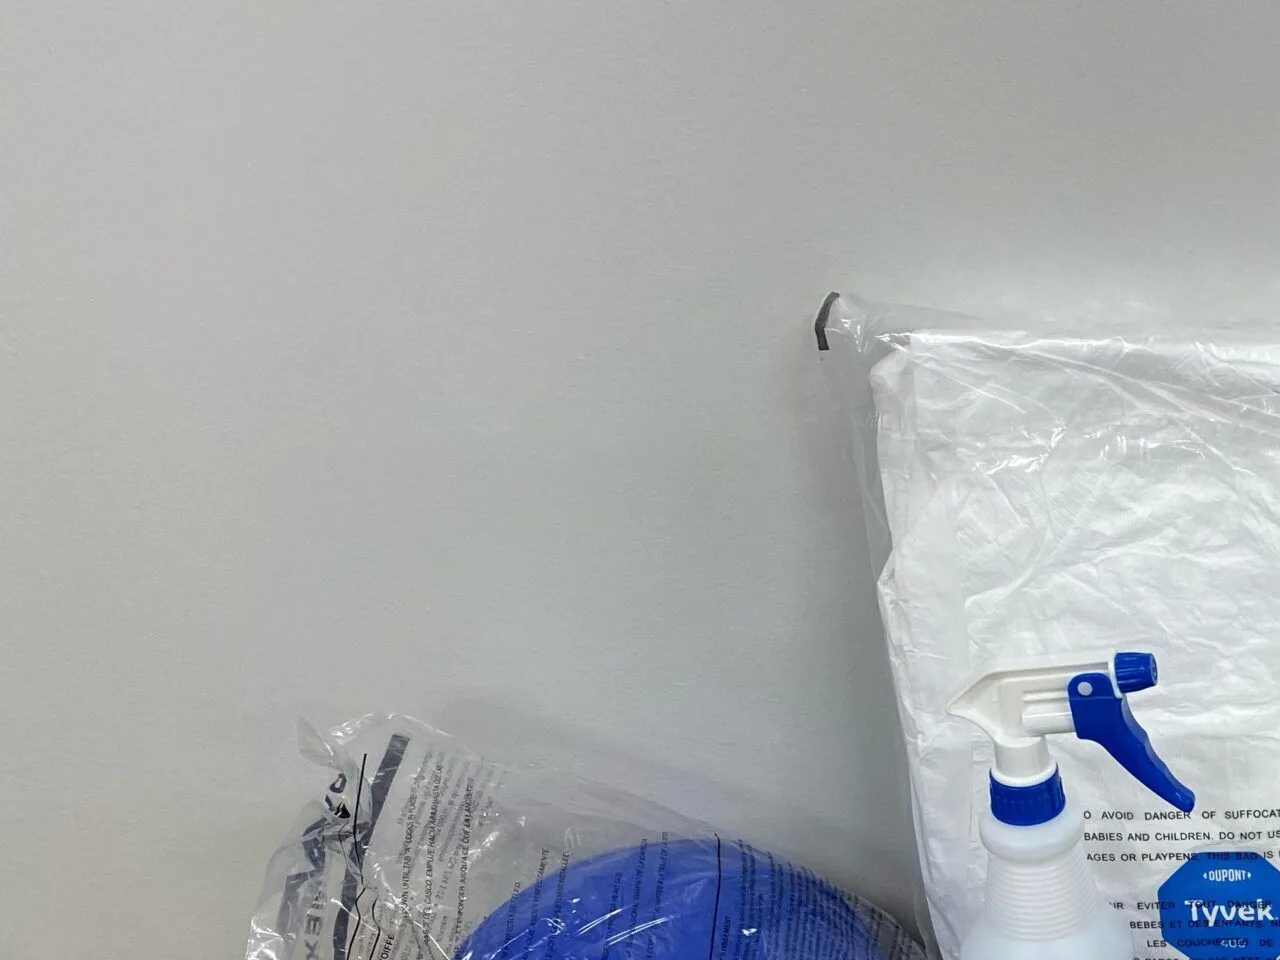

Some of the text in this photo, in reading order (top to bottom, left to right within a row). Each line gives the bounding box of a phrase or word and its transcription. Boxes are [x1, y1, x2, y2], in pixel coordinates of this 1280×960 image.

[1101, 811, 1134, 820] AVOID
[1144, 811, 1191, 820] DANGER
[1201, 810, 1216, 820] OF
[1083, 832, 1123, 841] BABIES
[1127, 832, 1150, 841] AND
[1219, 831, 1235, 840] DO
[1240, 831, 1262, 840] NOT
[1086, 853, 1116, 862] AGES
[1120, 853, 1137, 861] OR
[1207, 852, 1231, 861] THIS
[1235, 852, 1259, 861] BAG
[1263, 851, 1274, 859] IS
[1208, 870, 1247, 882] DUPONT
[1137, 902, 1176, 910] EVITER
[1184, 897, 1275, 928] Tyvek
[1129, 921, 1165, 930] BEBES
[1169, 921, 1183, 929] ET
[1187, 920, 1209, 929] DES
[1146, 939, 1273, 948] LES DE
